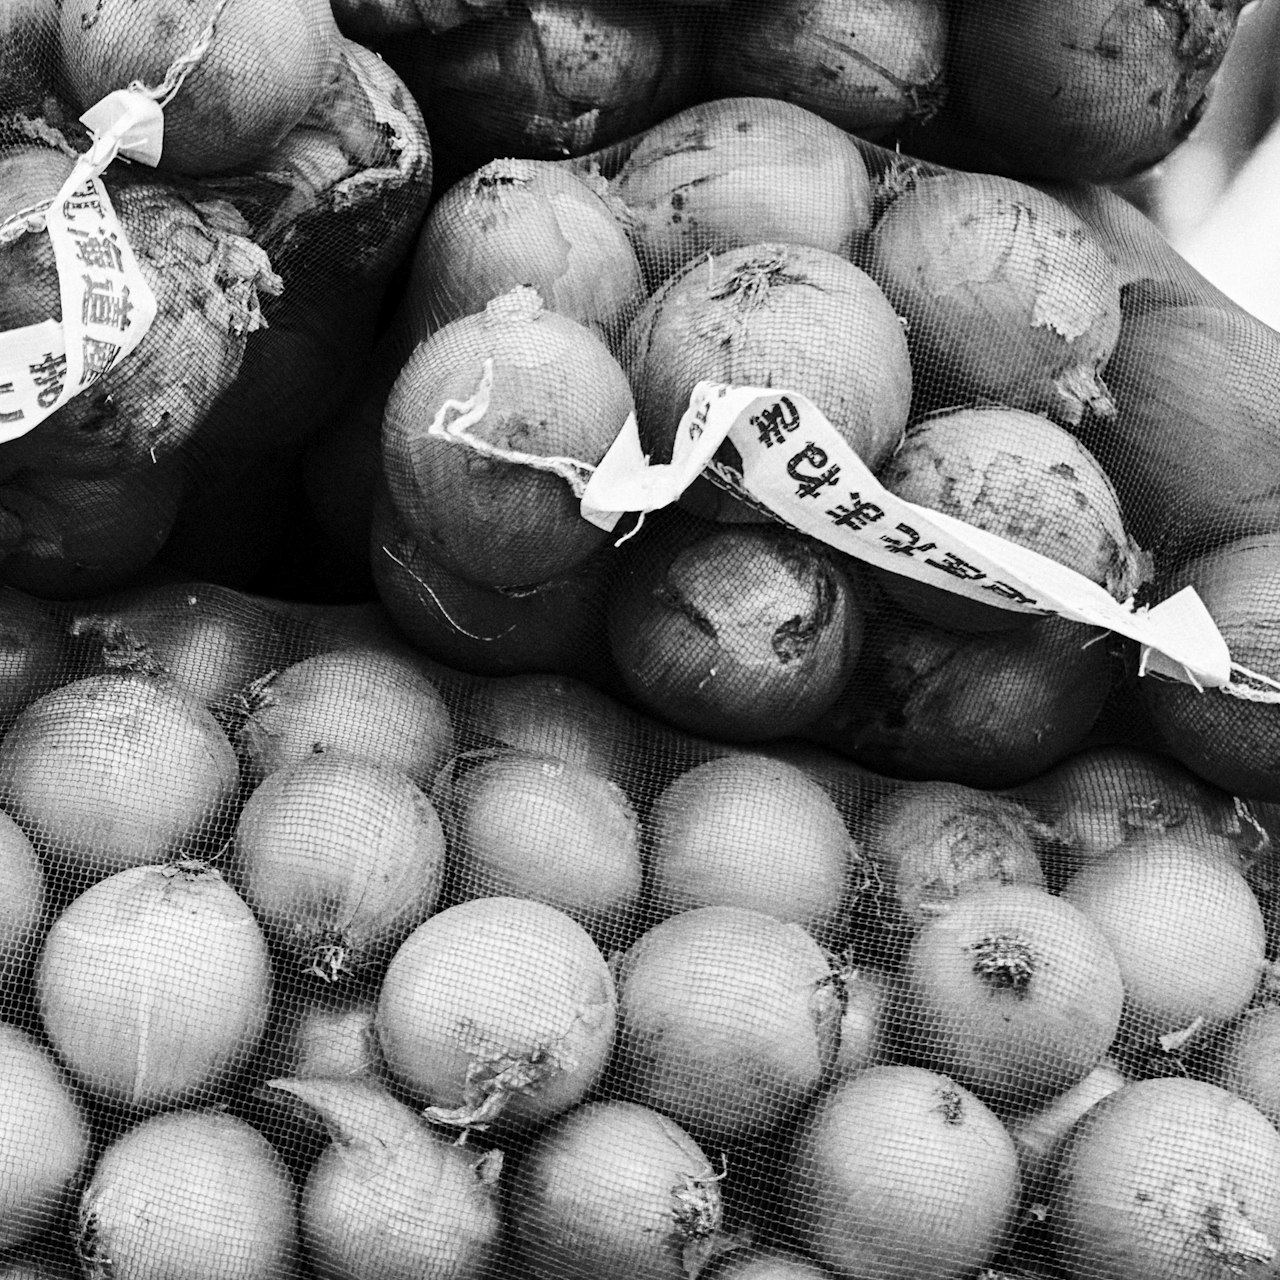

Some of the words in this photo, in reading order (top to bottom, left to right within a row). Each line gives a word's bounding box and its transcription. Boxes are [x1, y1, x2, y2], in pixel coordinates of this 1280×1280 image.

[749, 395, 1058, 615] 道産たまねぎ
